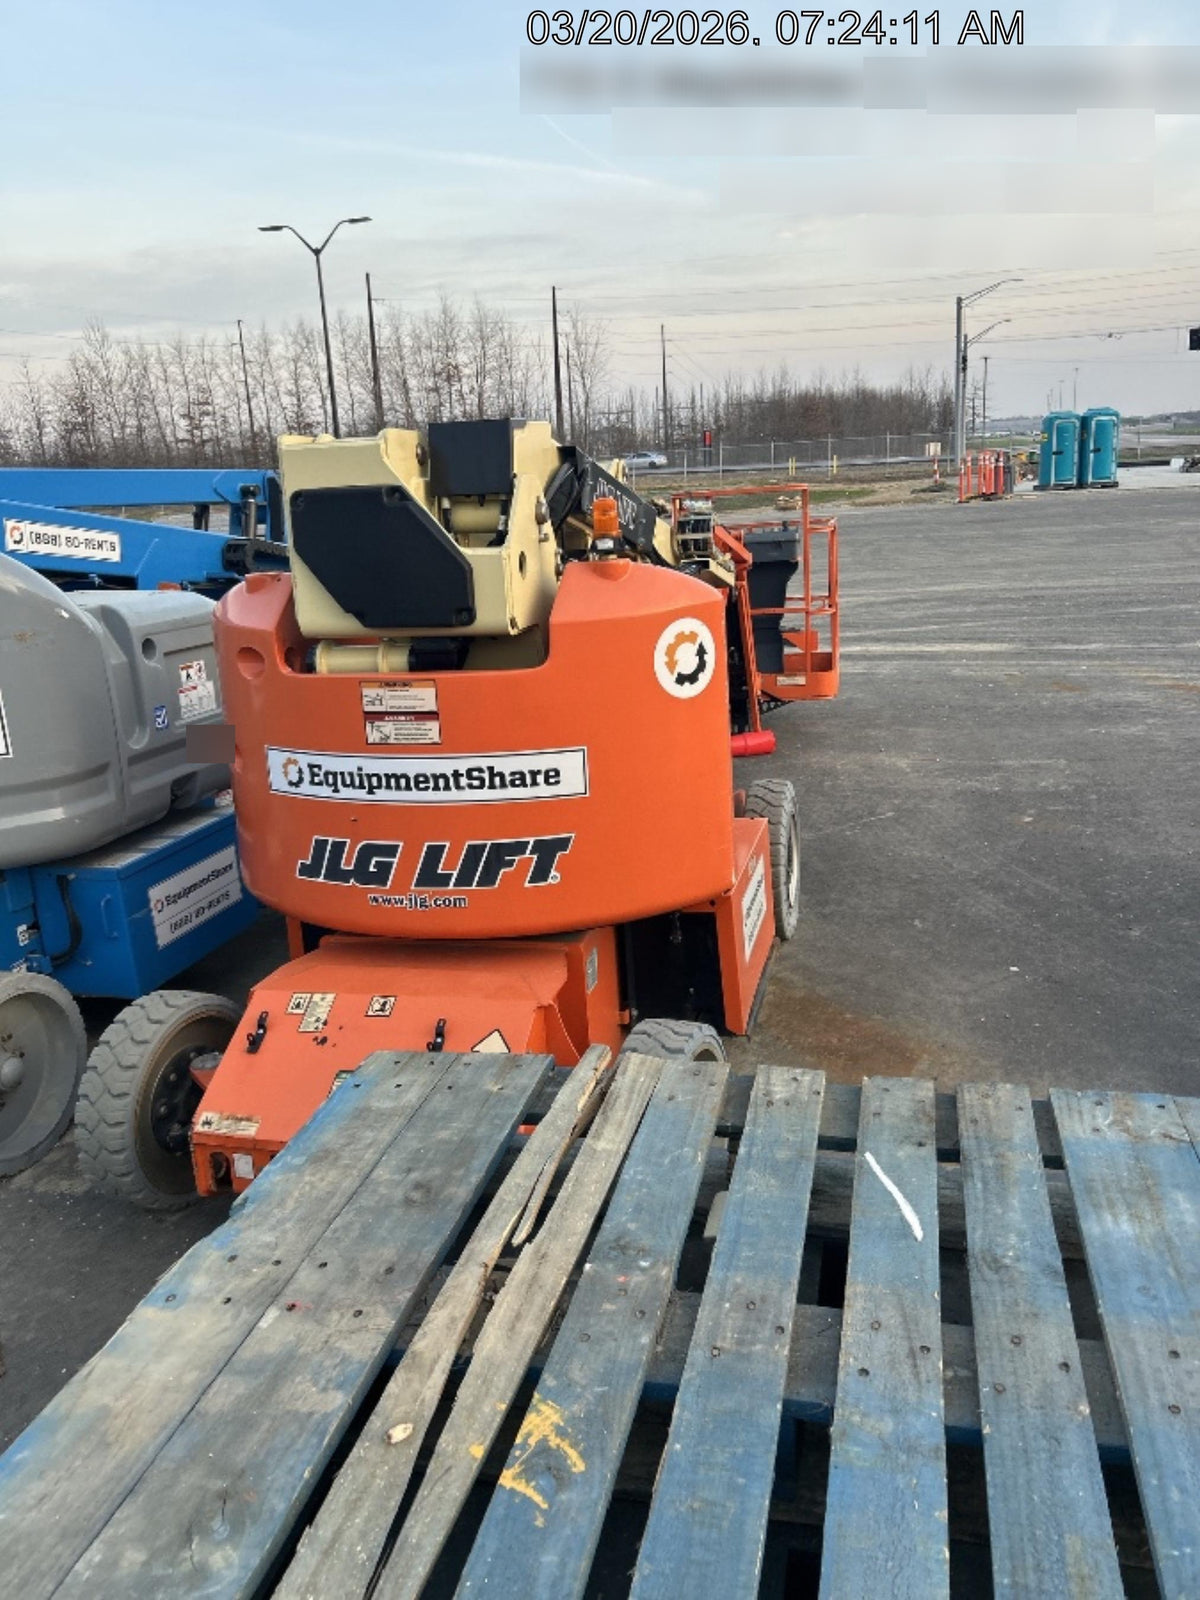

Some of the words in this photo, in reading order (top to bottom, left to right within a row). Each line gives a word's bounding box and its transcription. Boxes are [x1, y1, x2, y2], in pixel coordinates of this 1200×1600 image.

[307, 763, 561, 795] EquipmentShare
[296, 835, 404, 889] JLG
[411, 833, 576, 889] LIFT
[368, 892, 468, 910] www.jlg.com
